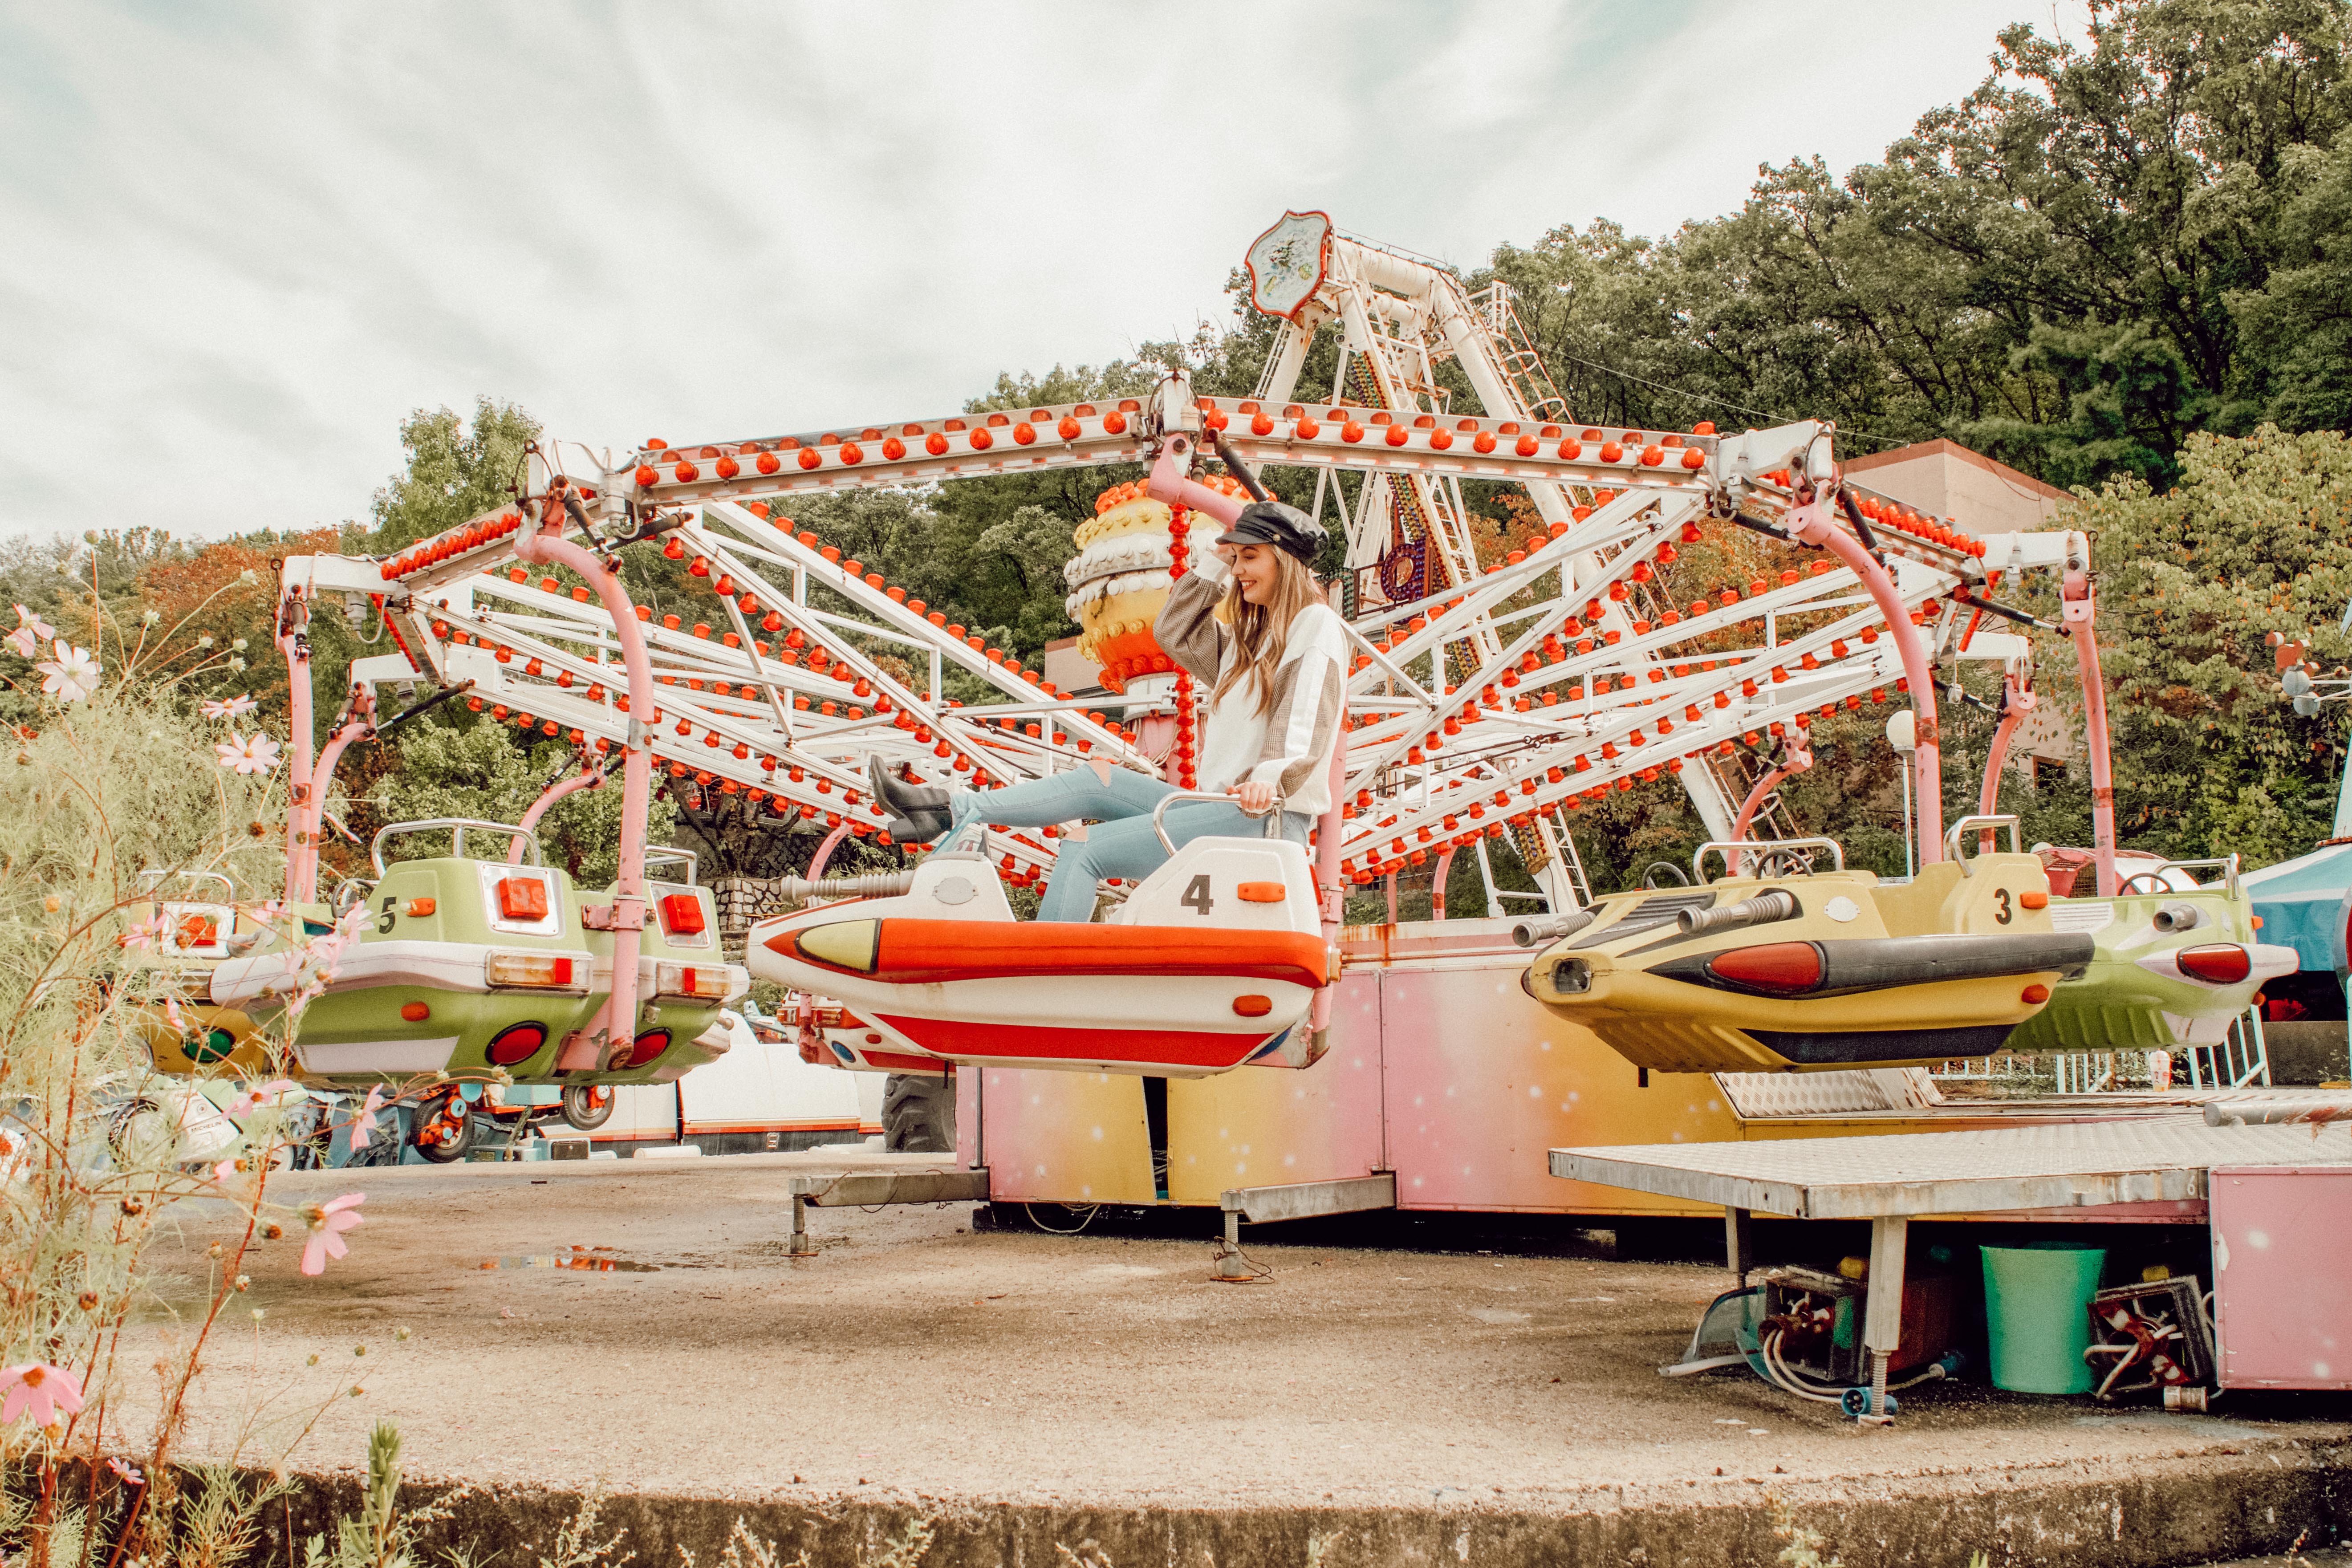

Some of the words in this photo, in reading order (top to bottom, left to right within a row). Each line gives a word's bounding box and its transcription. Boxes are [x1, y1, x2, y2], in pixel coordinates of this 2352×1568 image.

[1181, 874, 1213, 915] 4
[1995, 888, 2011, 925] 3
[379, 896, 397, 934] 5
[2187, 1175, 2195, 1195] 6
